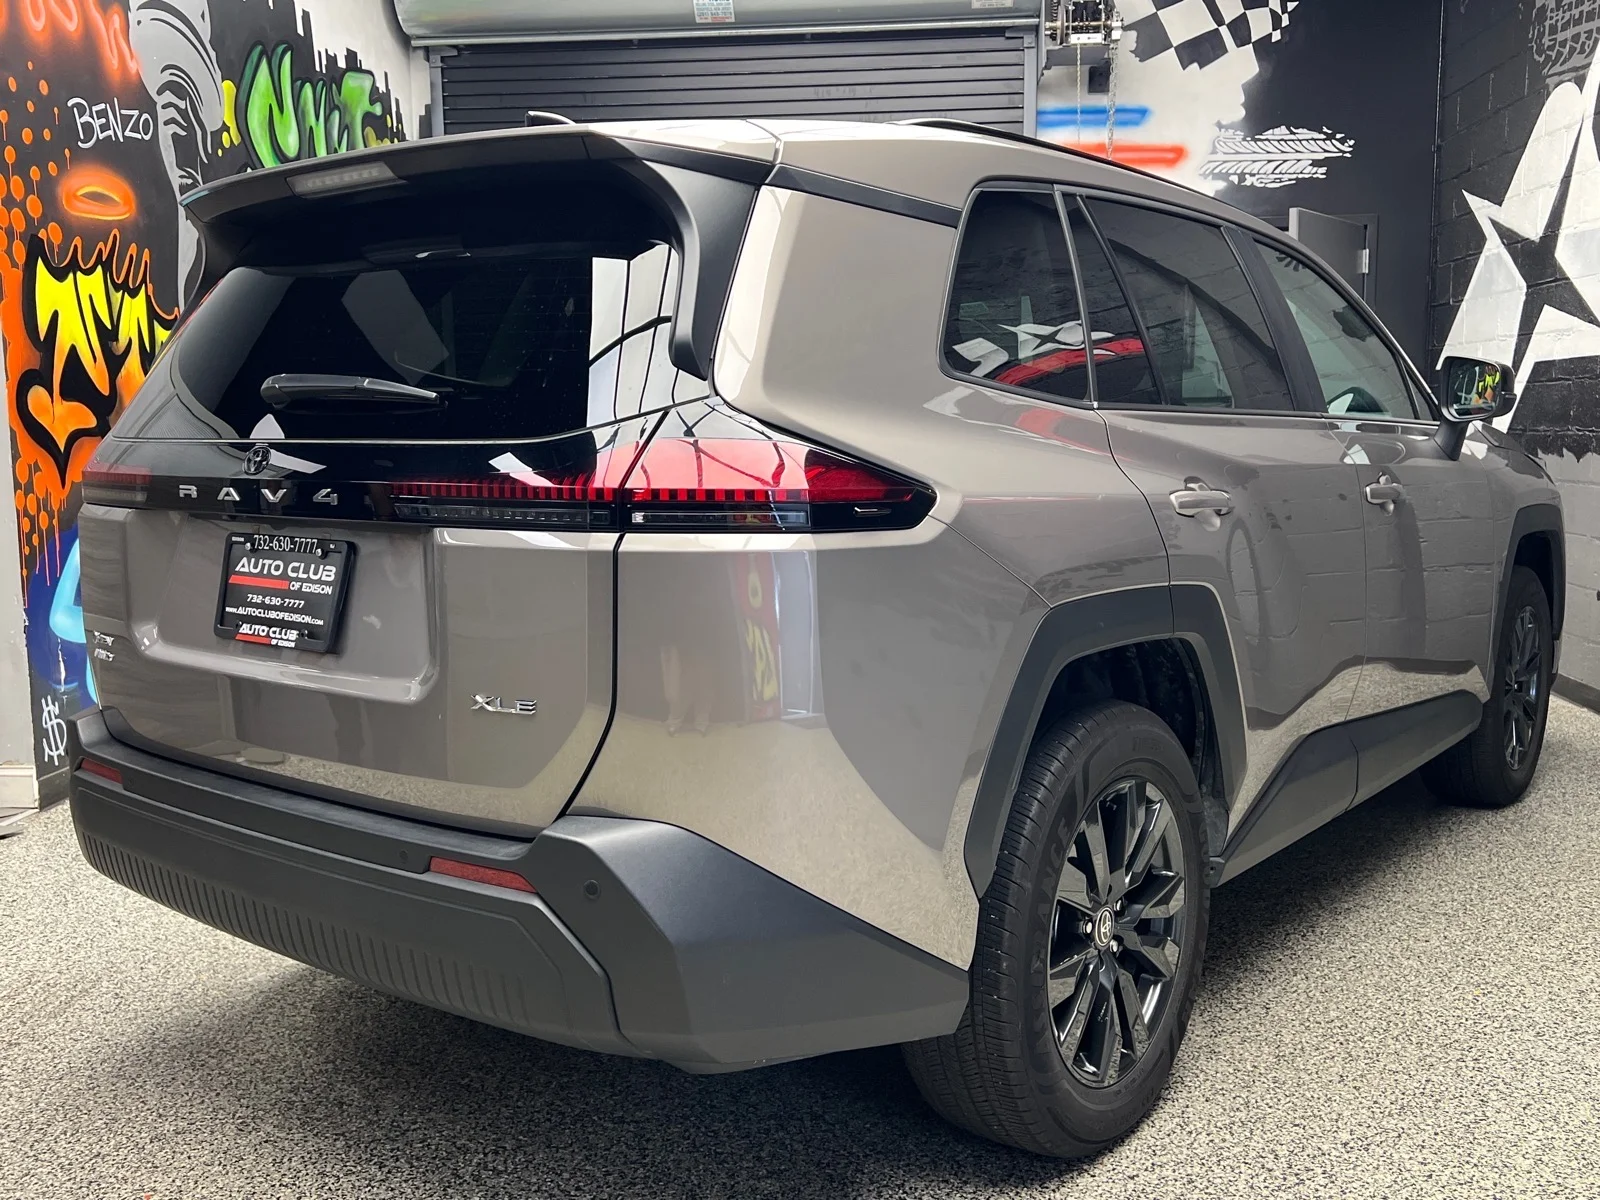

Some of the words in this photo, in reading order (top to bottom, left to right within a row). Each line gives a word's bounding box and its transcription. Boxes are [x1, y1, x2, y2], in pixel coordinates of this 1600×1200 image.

[67, 97, 153, 149] BENZO
[179, 485, 338, 505] RAV4
[253, 534, 318, 554] 732-630-7777
[235, 557, 284, 576] AUTO
[287, 562, 336, 581] CLUB
[290, 581, 301, 591] OF
[301, 583, 333, 595] EDISON
[246, 594, 305, 609] 732-630-7777
[239, 623, 269, 637] AUTO
[269, 627, 300, 641] CLUB
[470, 694, 537, 715] XLE
